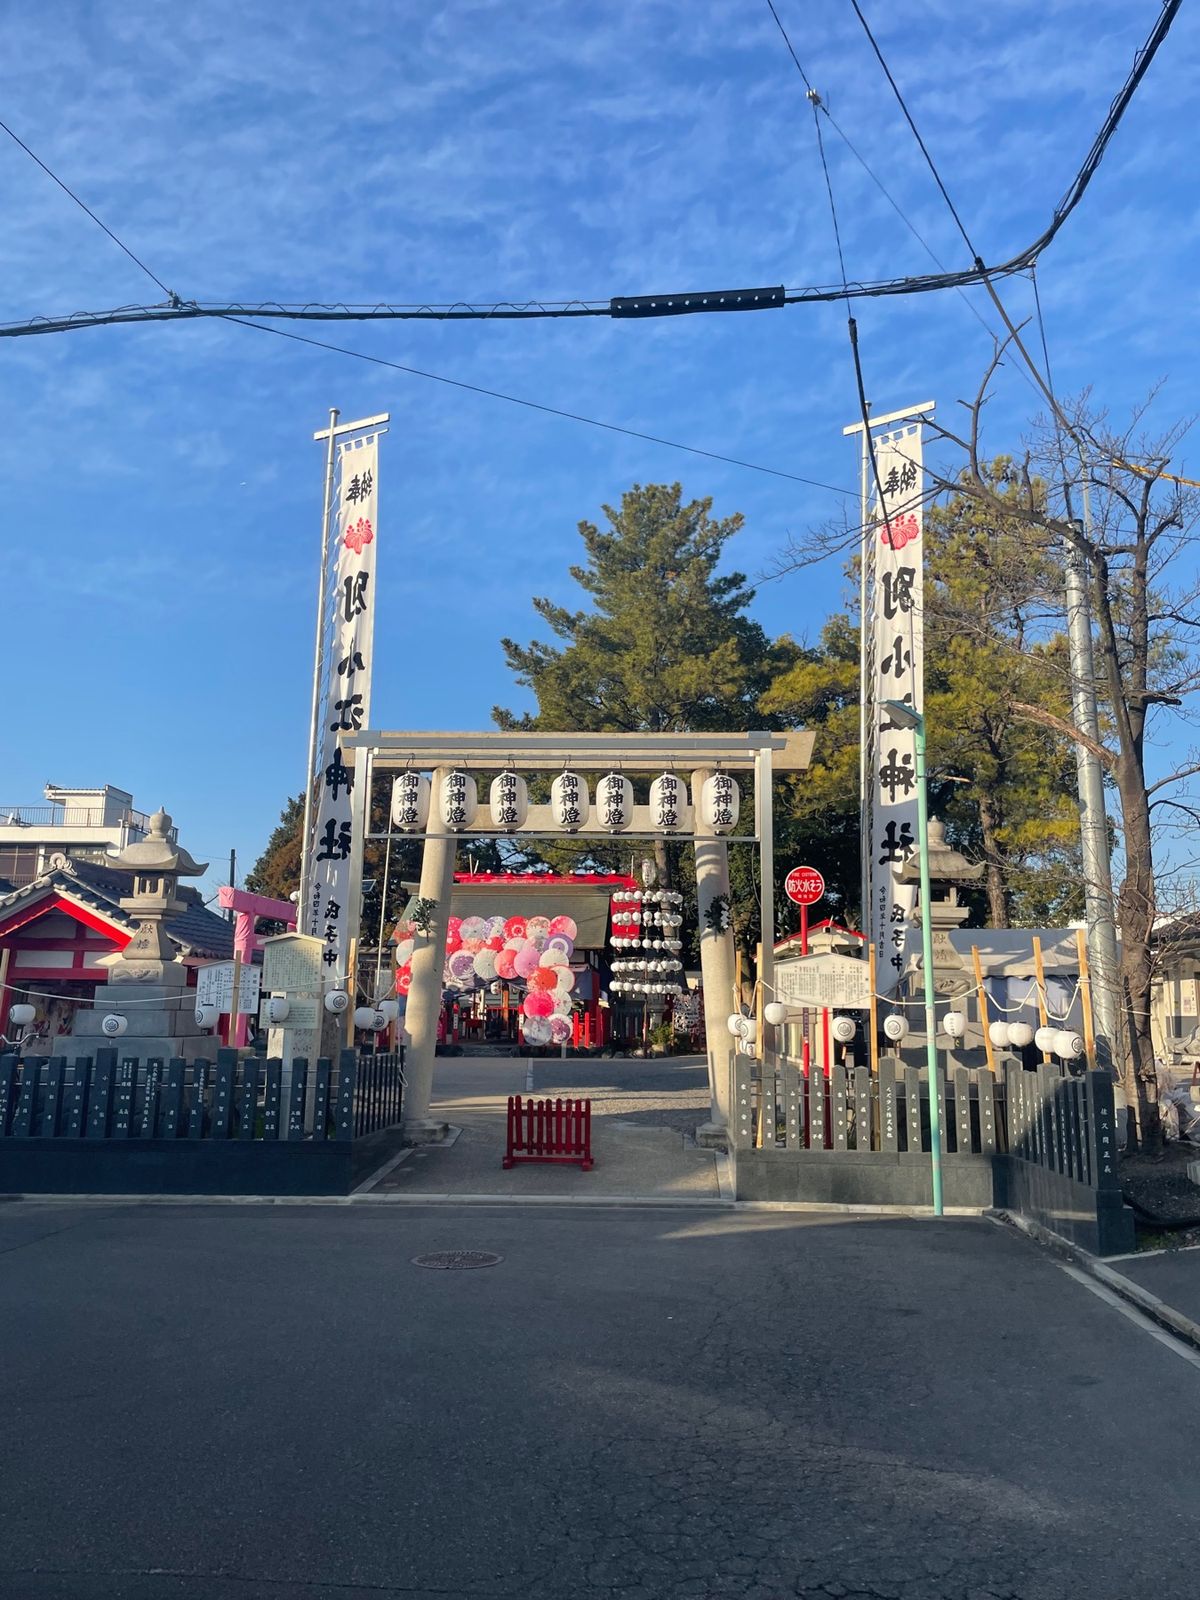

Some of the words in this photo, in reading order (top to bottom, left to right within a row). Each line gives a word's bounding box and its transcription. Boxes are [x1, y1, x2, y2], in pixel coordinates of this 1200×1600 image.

[398, 773, 419, 824] 御神燈
[445, 773, 466, 824] 御神燈
[497, 774, 518, 824] 御神燈
[560, 774, 580, 824] 御神燈
[603, 775, 624, 826] 御神燈
[657, 776, 678, 827] 御神燈
[712, 776, 733, 826] 御神燈
[788, 879, 822, 893] 防火水そう
